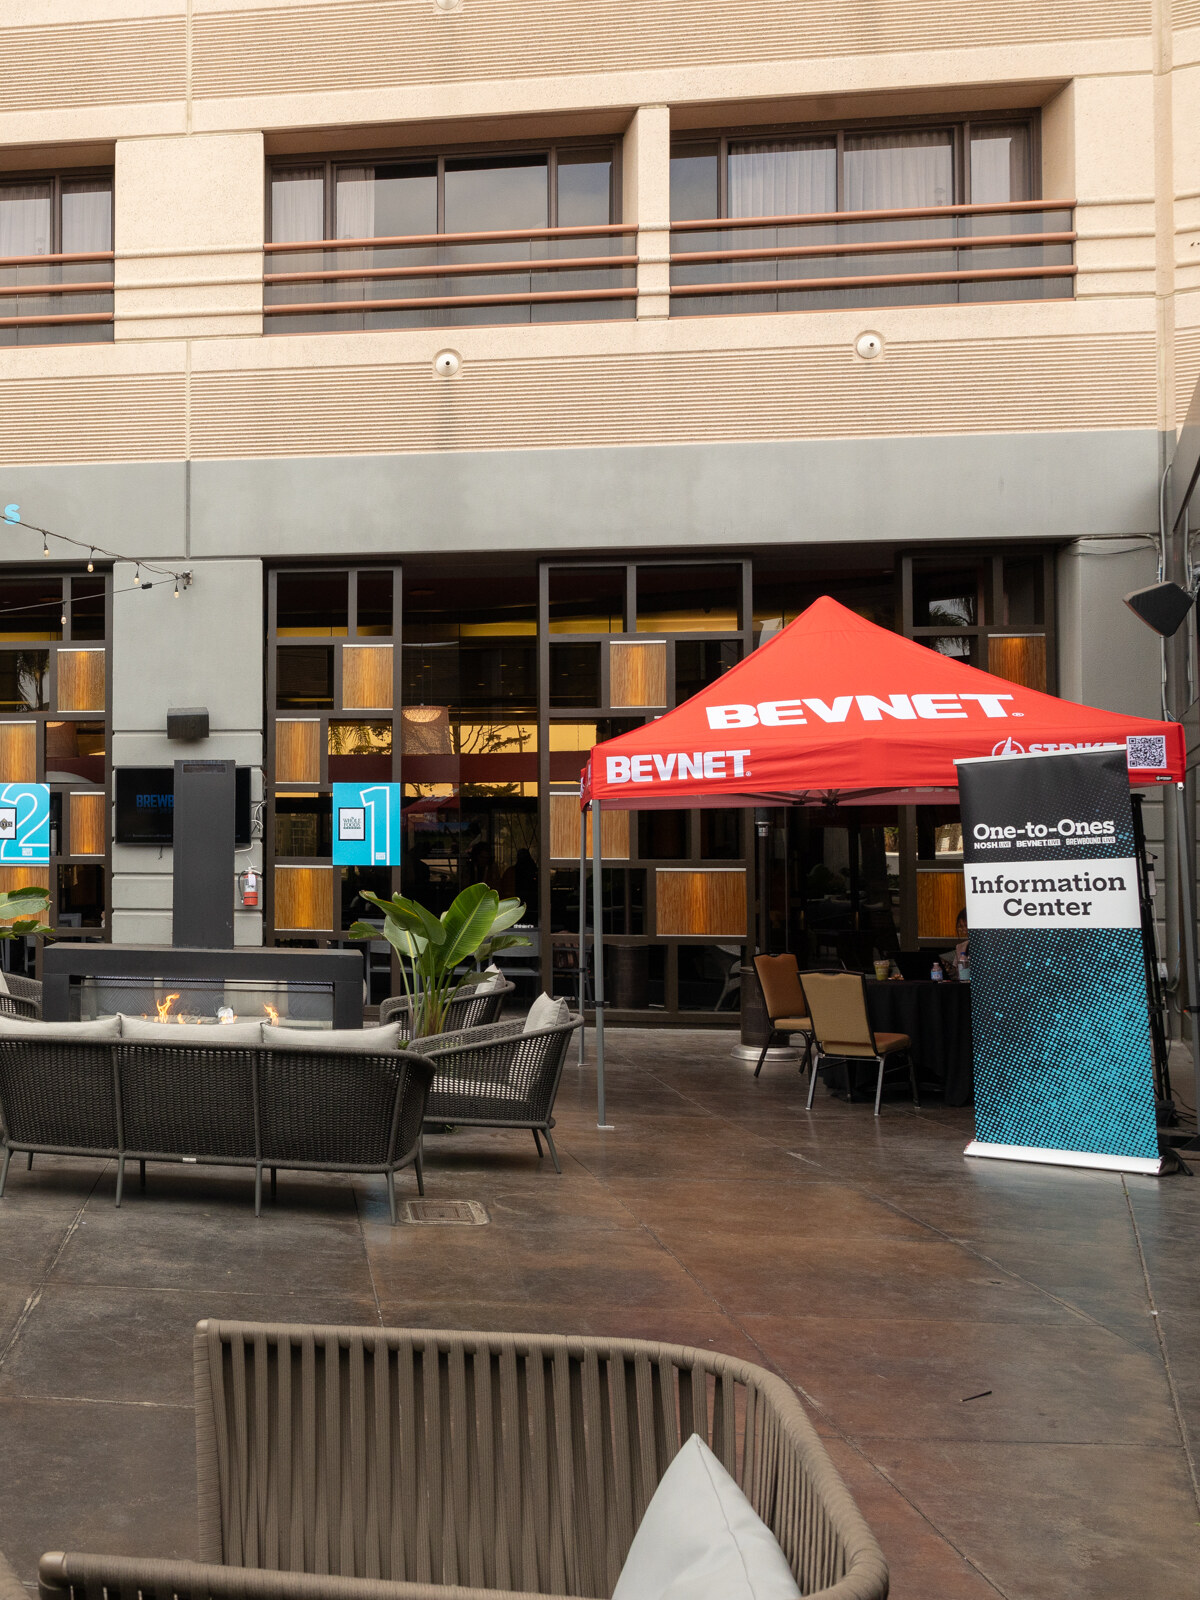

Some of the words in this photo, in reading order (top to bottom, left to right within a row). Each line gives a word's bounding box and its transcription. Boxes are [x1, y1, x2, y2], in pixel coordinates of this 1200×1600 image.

[136, 794, 174, 807] BREWB
[1, 784, 49, 860] 2
[360, 786, 390, 866] 1
[973, 818, 1116, 841] One-to-Ones
[974, 841, 998, 849] NOSH
[1016, 839, 1048, 848] BEVNET
[970, 871, 1127, 894] Information
[1003, 898, 1092, 917] Center
